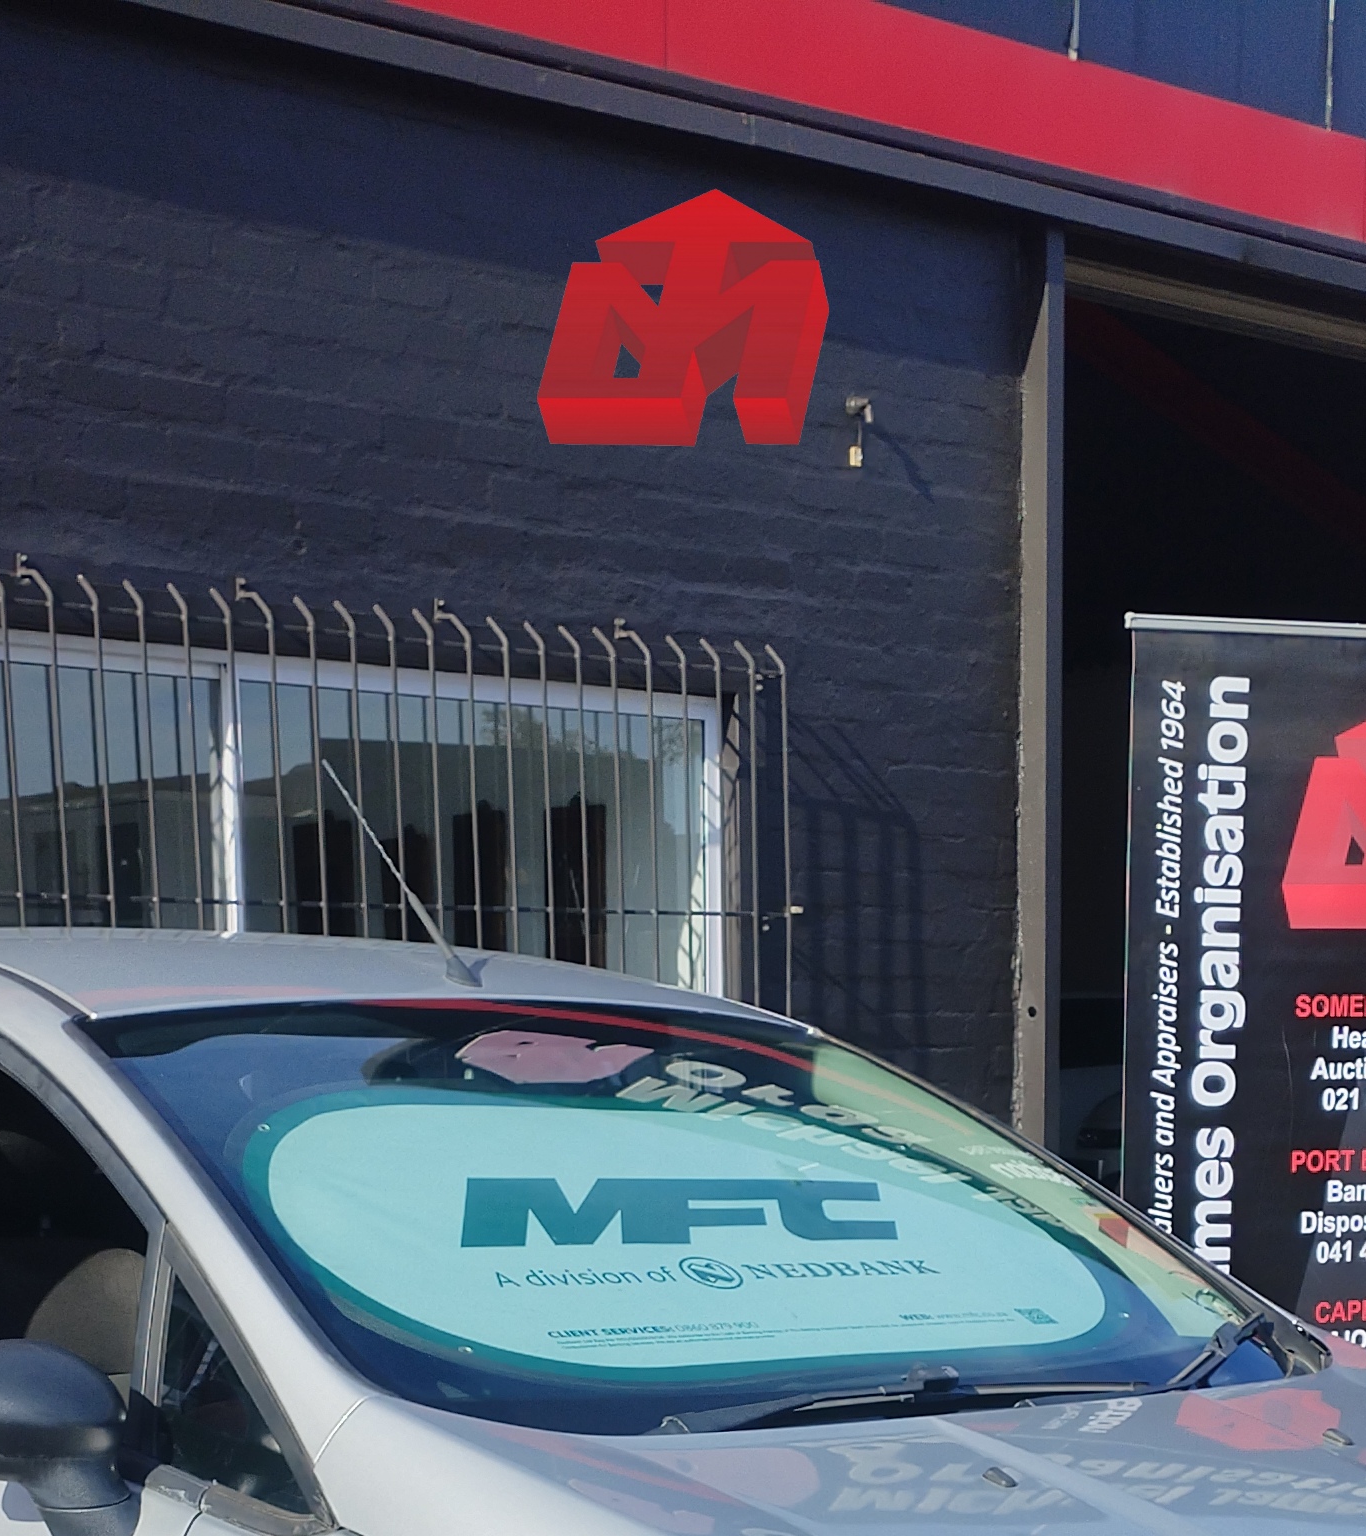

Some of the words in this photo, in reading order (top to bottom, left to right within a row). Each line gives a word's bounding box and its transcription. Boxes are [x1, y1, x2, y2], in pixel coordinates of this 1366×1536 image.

[1161, 679, 1187, 750] 1964
[1156, 757, 1184, 919] Established
[1190, 675, 1251, 1108] Organisation
[1151, 941, 1182, 1088] Appraisers
[1150, 1091, 1176, 1147] and
[1321, 1087, 1360, 1111] 021
[1290, 1149, 1355, 1174] PORT
[460, 1178, 899, 1248] MFC
[1194, 1125, 1235, 1276] mes
[495, 1270, 522, 1290] A
[525, 1268, 643, 1288] division
[647, 1266, 676, 1284] of
[743, 1259, 940, 1279] NEDBANK
[1316, 1239, 1353, 1264] 041
[547, 1328, 598, 1339] CLIENT
[601, 1325, 672, 1336] SERVICES:
